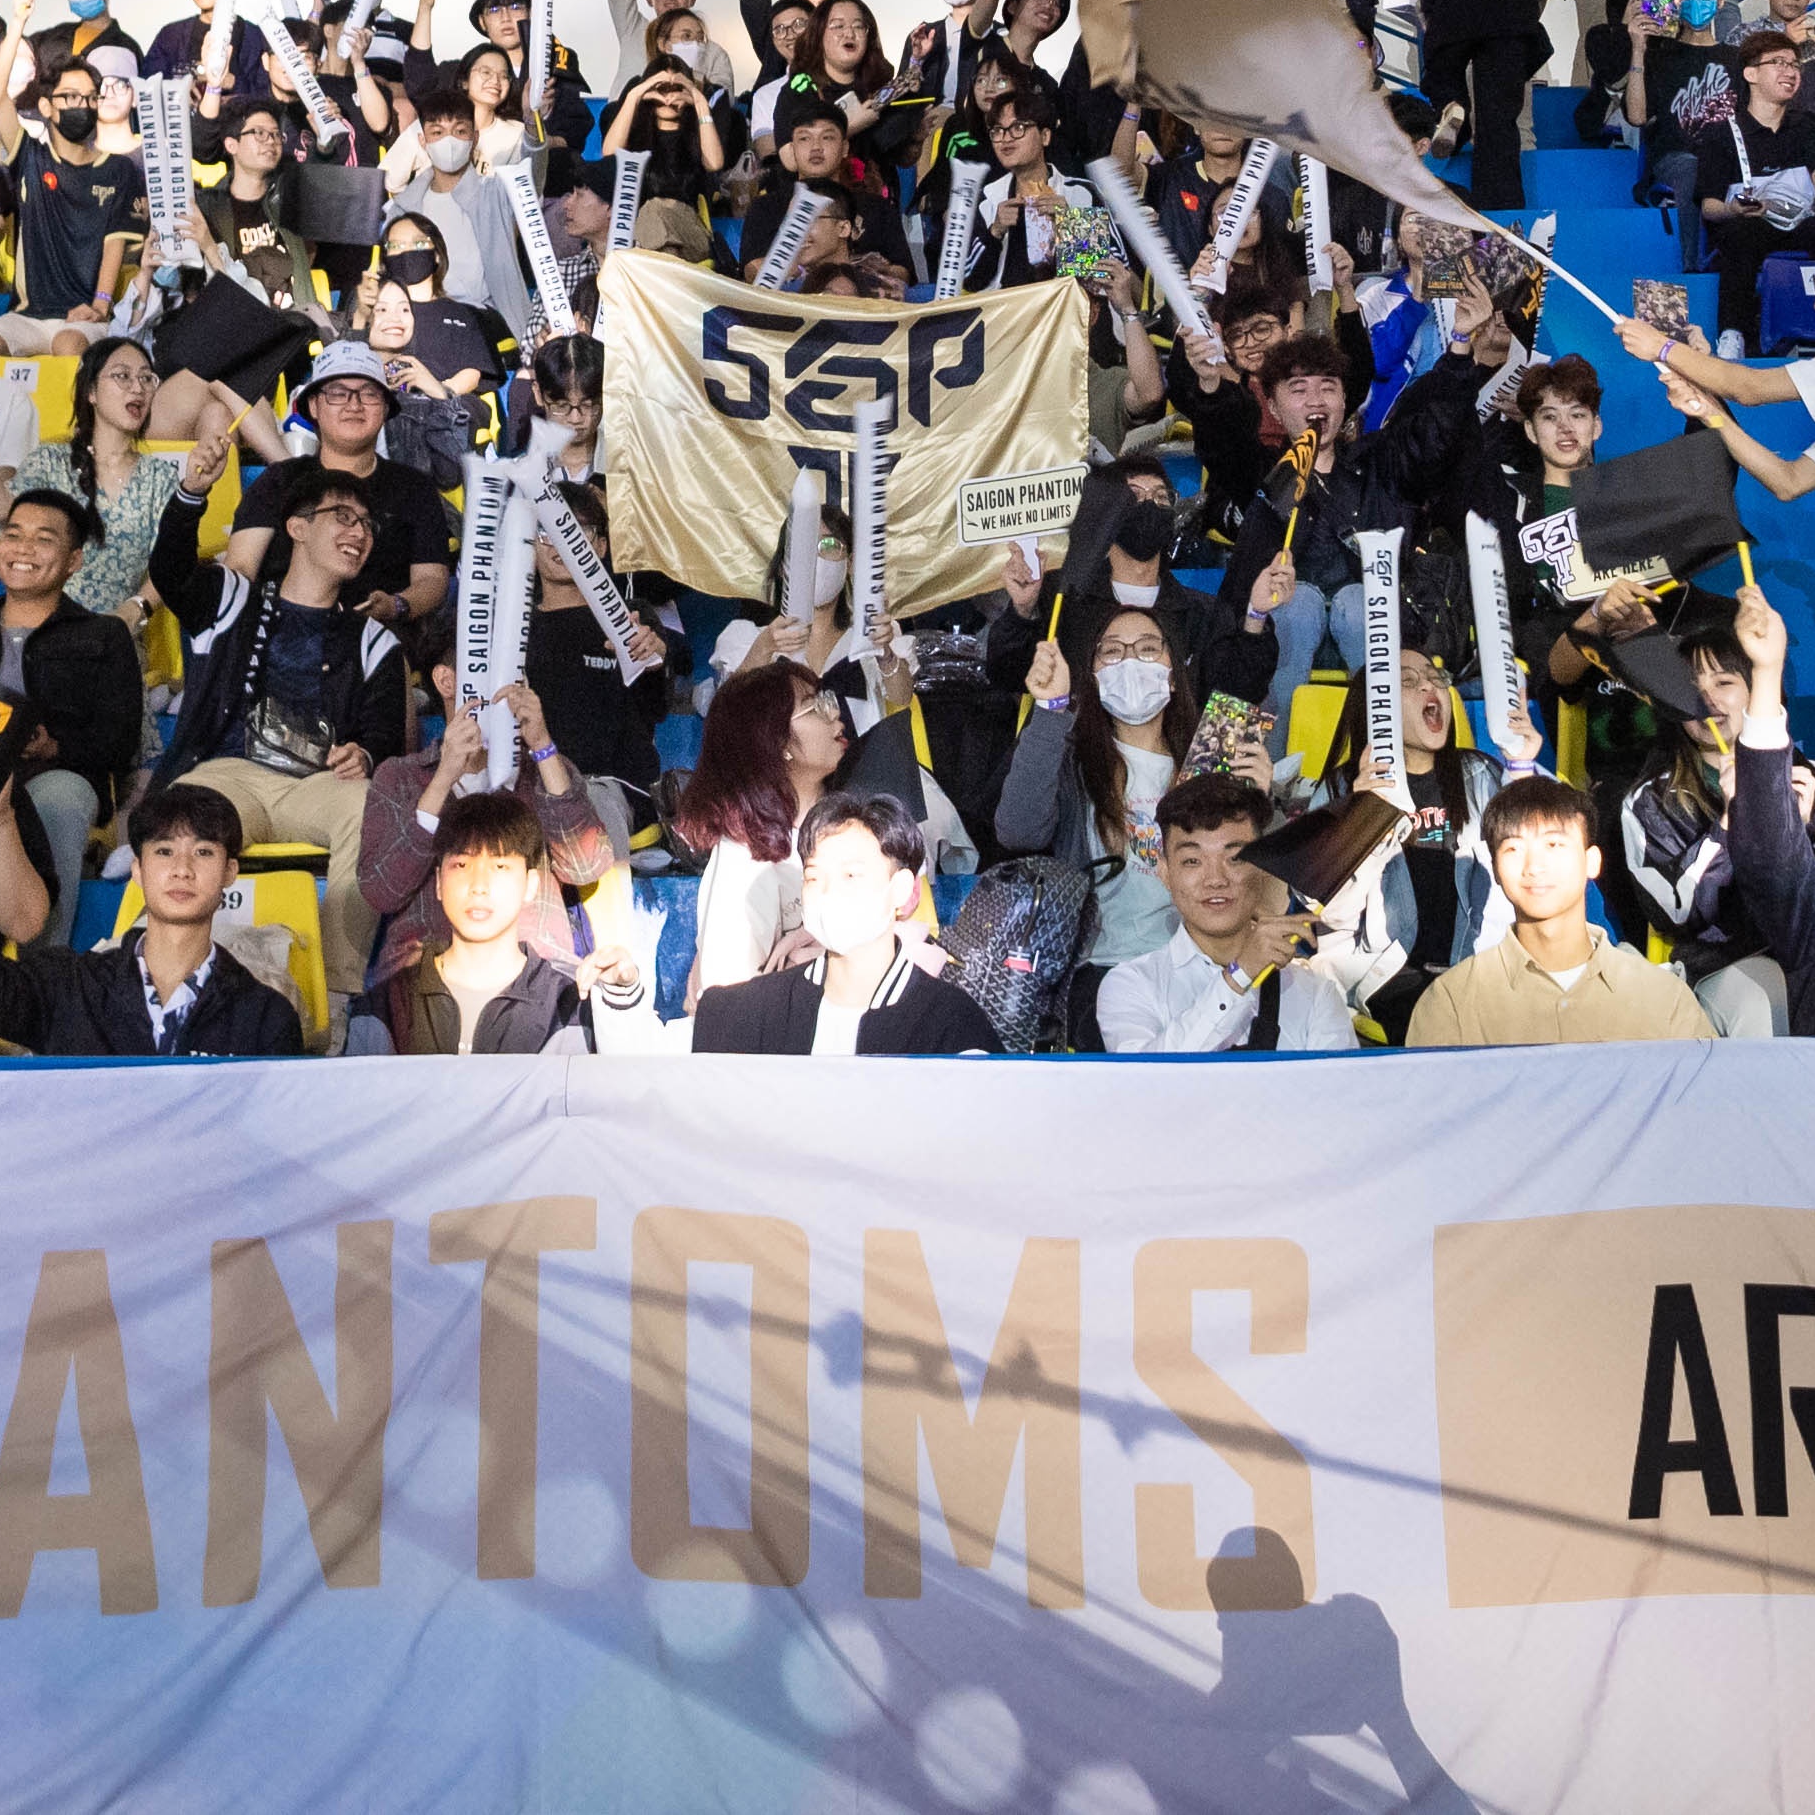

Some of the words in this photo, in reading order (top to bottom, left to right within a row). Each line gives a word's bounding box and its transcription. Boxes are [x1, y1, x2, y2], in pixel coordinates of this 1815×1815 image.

[273, 28, 303, 69] SAIGON
[298, 71, 336, 125] PHANTOM
[139, 91, 159, 159] PHANTOM
[167, 90, 185, 159] PHANTOM
[148, 165, 166, 219] SAIGON
[515, 175, 549, 248] PHANTOM
[616, 161, 639, 231] PHANTOM
[1219, 183, 1250, 237] SAIGON
[771, 200, 816, 270] PHANTOM
[539, 255, 568, 313] SAIGON
[10, 367, 32, 382] 37
[703, 305, 985, 432] SGP
[472, 476, 504, 582] PHANTOM
[967, 488, 1015, 513] SAIGON
[1020, 476, 1083, 505] PHANTOM
[980, 516, 996, 531] WE
[1000, 512, 1024, 528] HAVE
[1025, 509, 1039, 525] NO
[1041, 505, 1072, 523] LIMITS
[555, 510, 600, 579] SAIGON
[1522, 513, 1579, 563] SG
[468, 592, 490, 674] SAIGON
[583, 654, 618, 670] TEDDY
[1368, 596, 1391, 674] SAIGON
